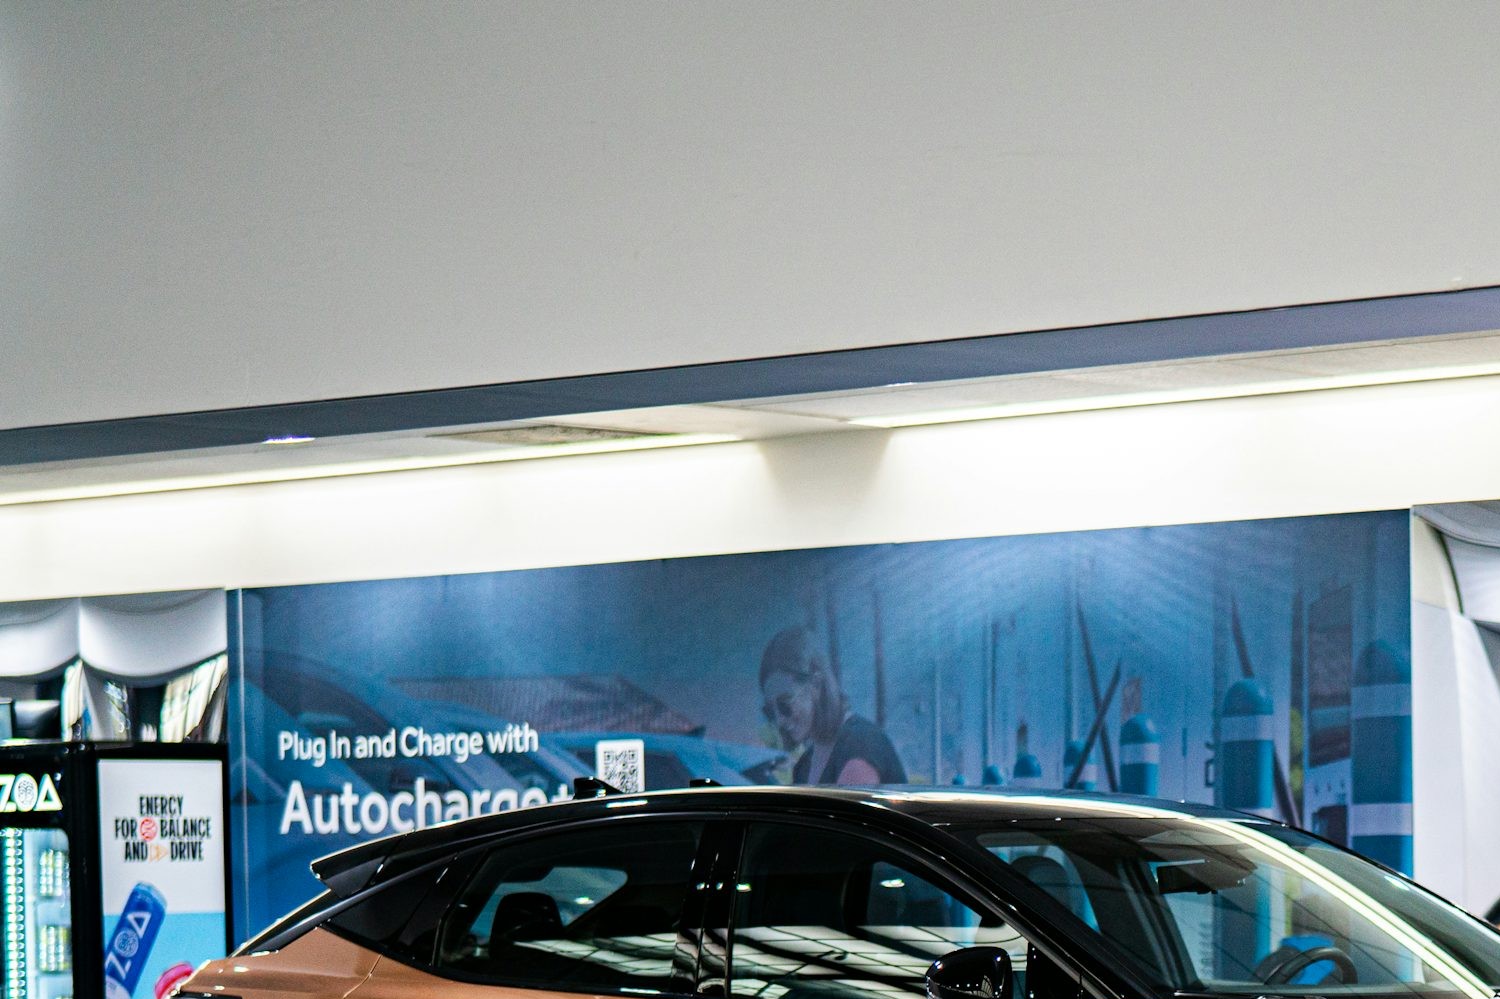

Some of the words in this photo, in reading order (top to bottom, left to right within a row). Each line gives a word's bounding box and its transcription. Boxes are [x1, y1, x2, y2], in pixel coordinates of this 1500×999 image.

[278, 730, 326, 768] Plug
[331, 728, 351, 759] In
[355, 727, 396, 759] and
[399, 724, 483, 763] Charge
[487, 722, 539, 754] with
[138, 794, 184, 817] ENERGY
[115, 817, 138, 839] FOR
[159, 817, 212, 839] BALANCE
[124, 841, 148, 861] AND
[170, 841, 204, 861] DRIVE
